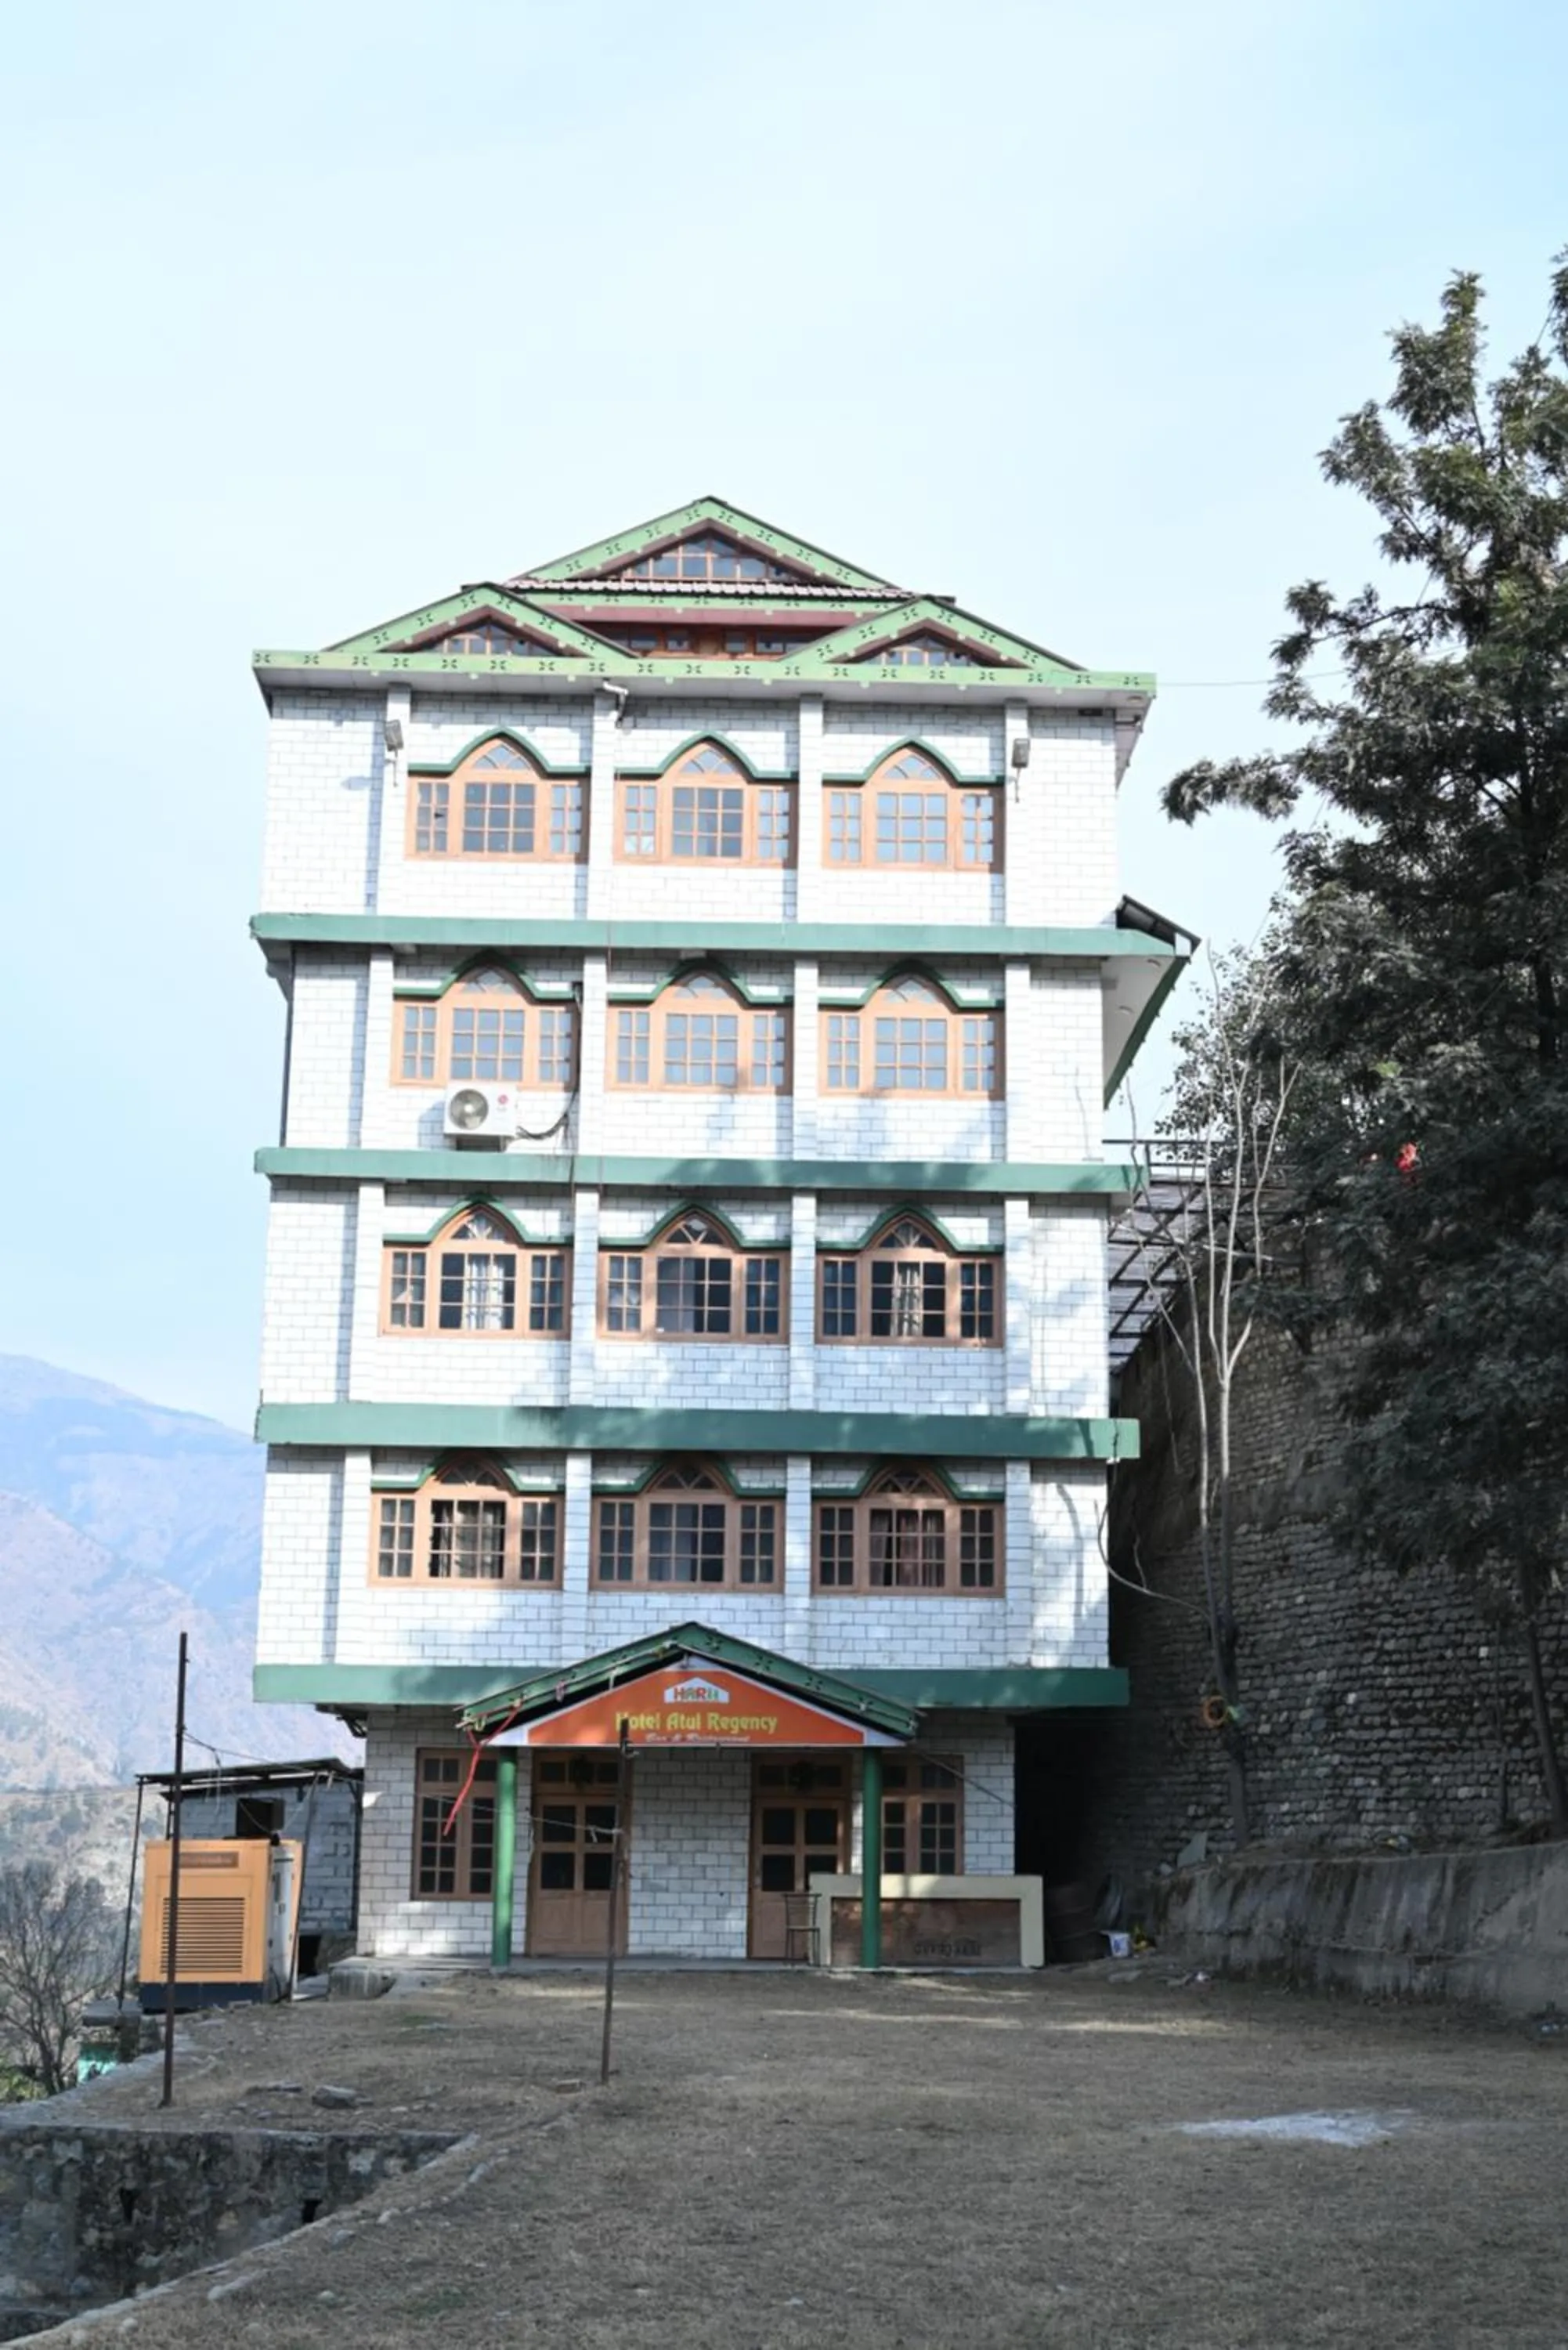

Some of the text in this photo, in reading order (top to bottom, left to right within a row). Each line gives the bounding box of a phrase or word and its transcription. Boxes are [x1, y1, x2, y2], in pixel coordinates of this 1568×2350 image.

[615, 1711, 778, 1734] Hotel Atul Regency
